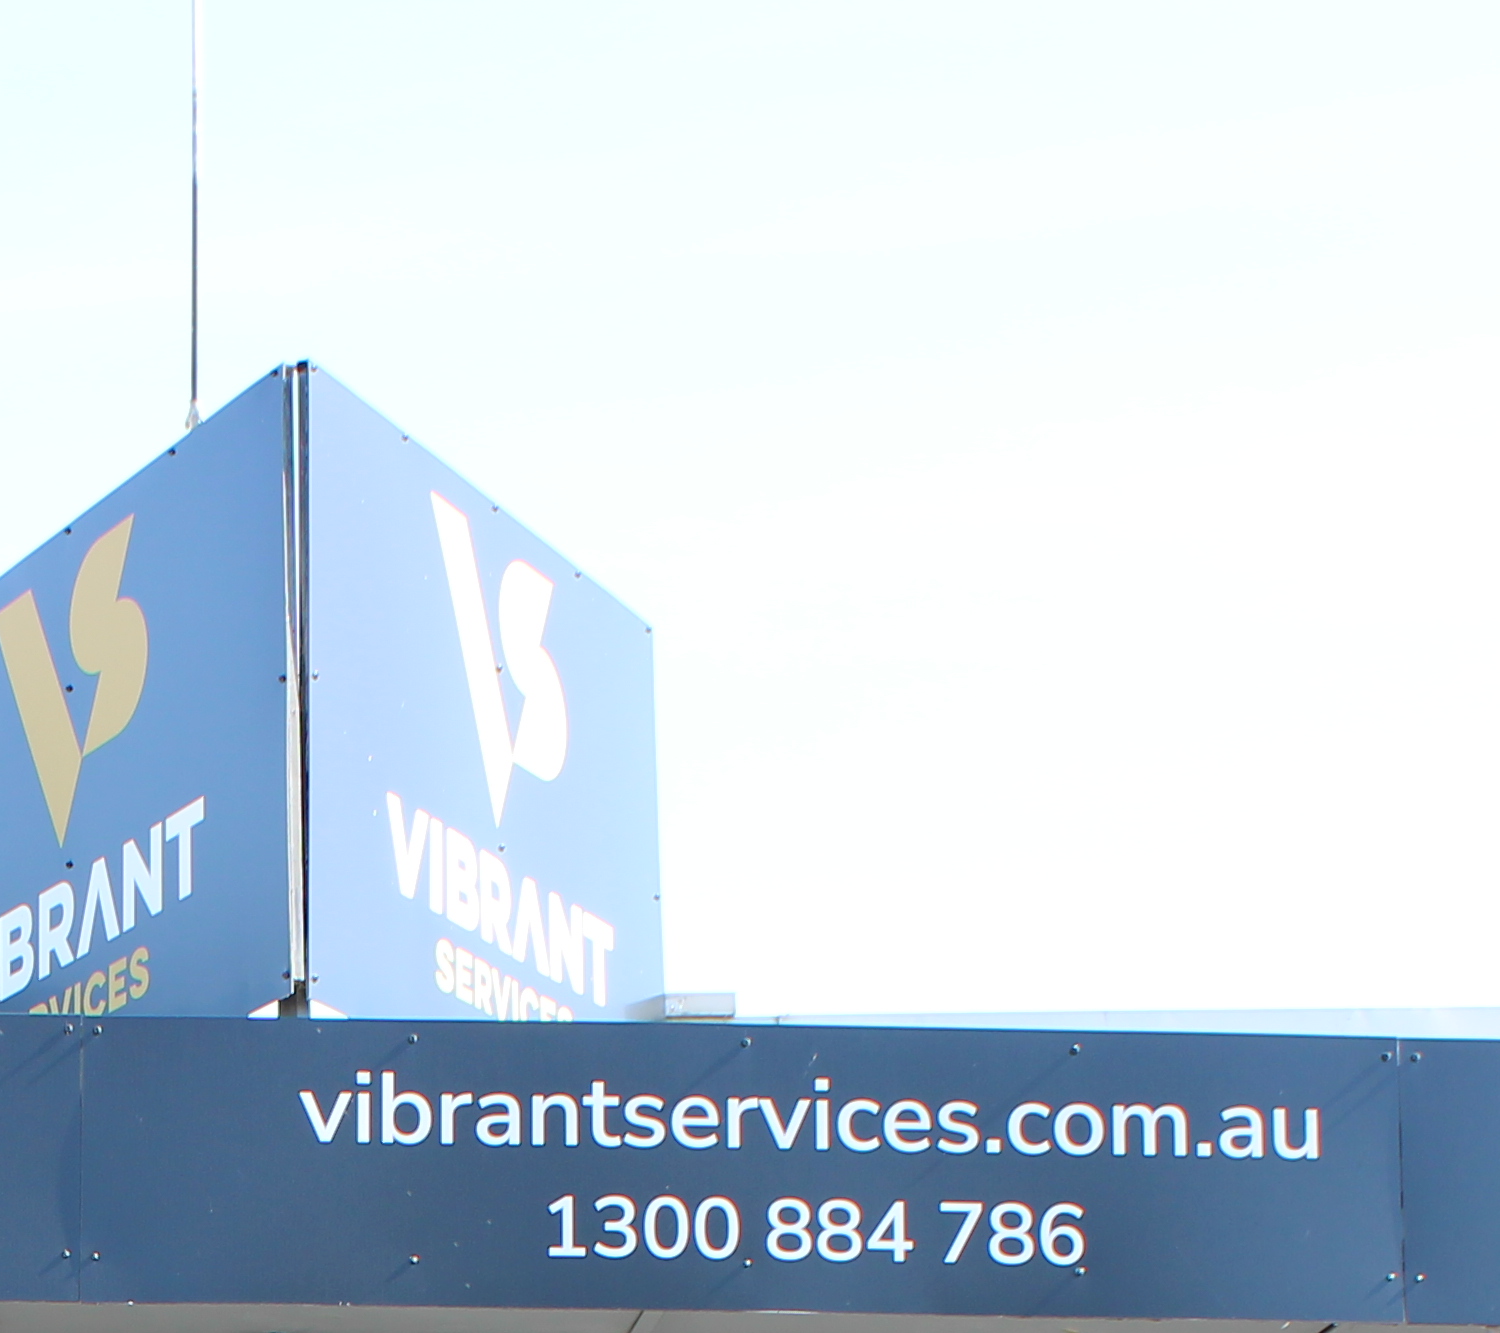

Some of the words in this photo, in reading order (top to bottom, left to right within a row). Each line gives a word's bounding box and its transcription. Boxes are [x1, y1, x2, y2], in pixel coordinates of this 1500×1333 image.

[386, 791, 615, 1009] VIBRANT
[298, 1070, 1320, 1163] vibrantservices.com.au
[546, 1194, 740, 1261] 1300
[764, 1198, 913, 1264] 884
[940, 1201, 1086, 1268] 786
